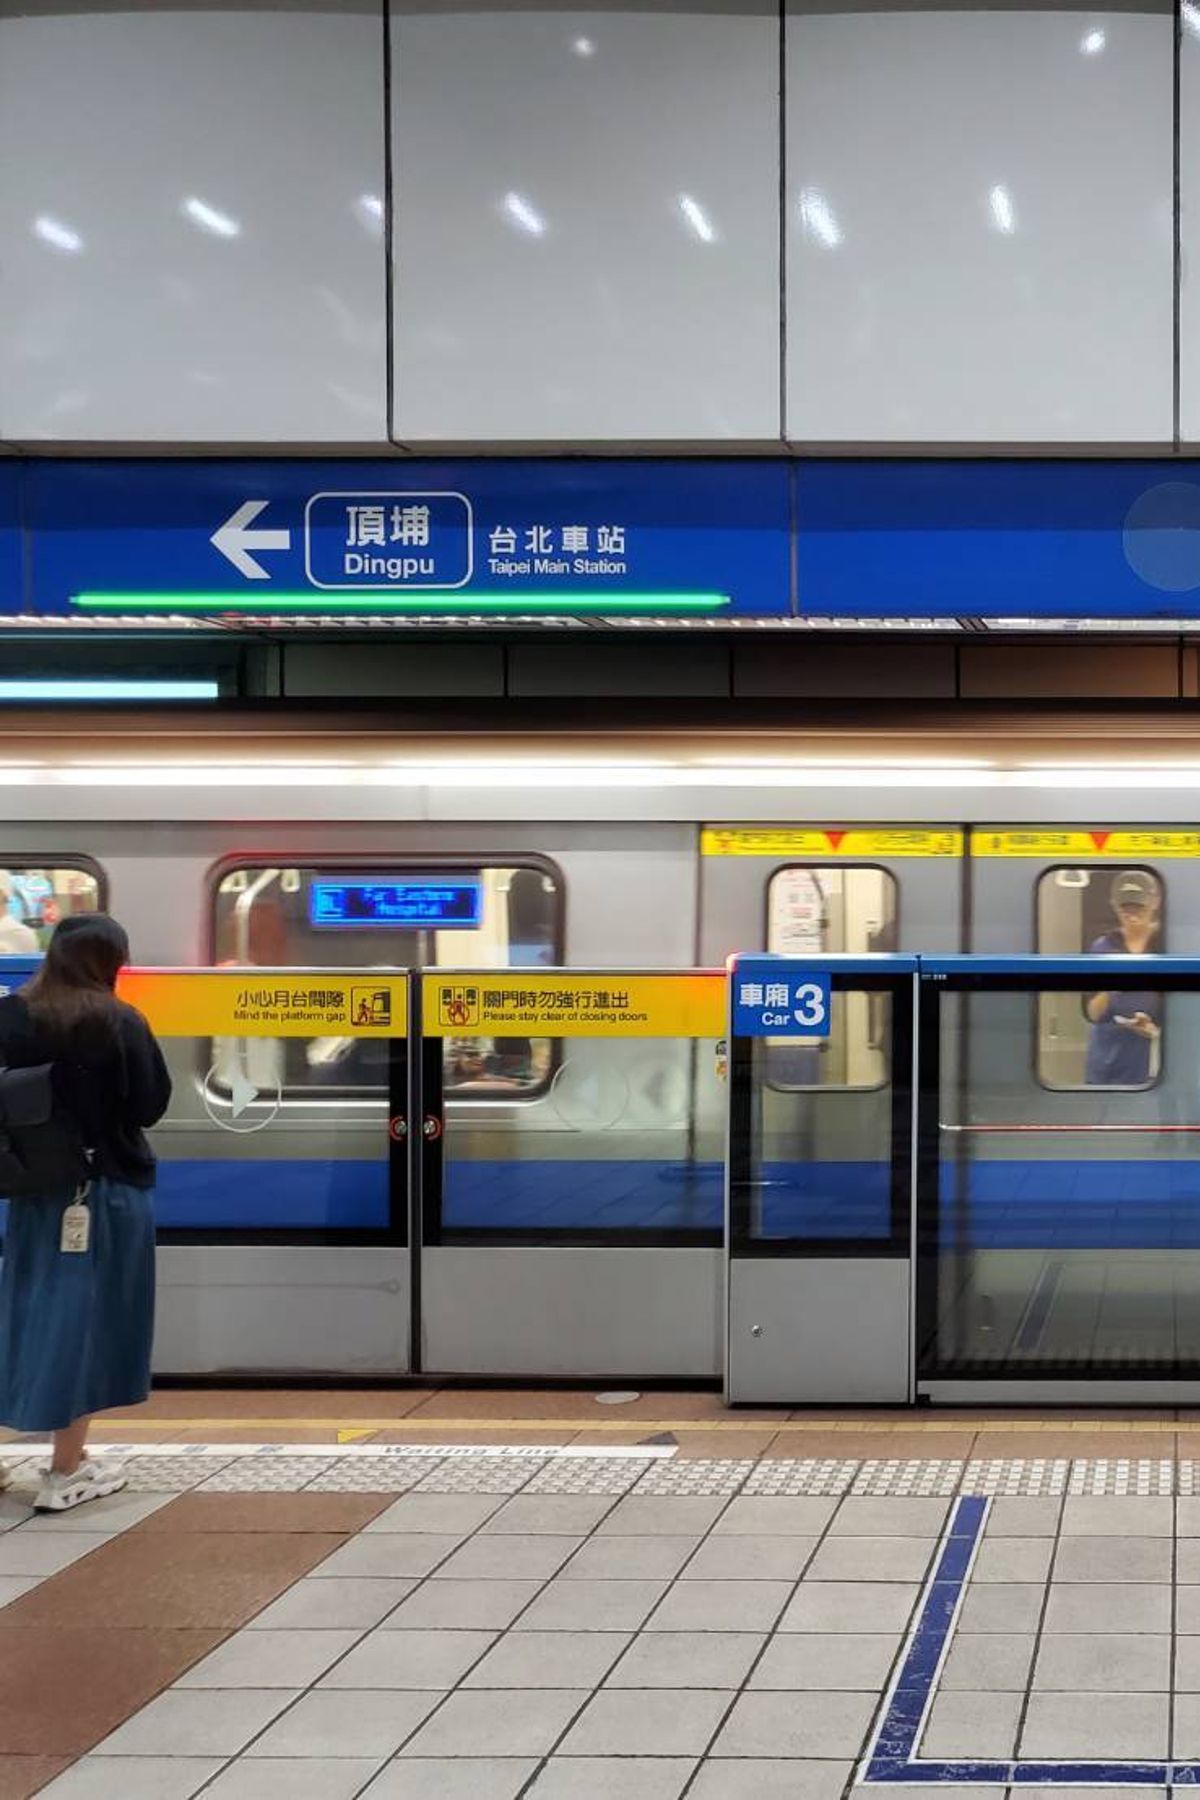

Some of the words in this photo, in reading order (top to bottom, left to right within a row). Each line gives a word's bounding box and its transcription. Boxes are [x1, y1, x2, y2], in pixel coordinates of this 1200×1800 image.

[346, 506, 430, 546] 頂埔
[489, 525, 626, 554] 台北車站
[344, 553, 434, 579] Dingpu
[488, 558, 531, 575] Taipei
[534, 558, 570, 574] Main
[573, 558, 626, 574] Station
[237, 989, 344, 1008] 小心月台間隙
[739, 983, 790, 1008] 車廂
[794, 983, 825, 1026] 3
[233, 1010, 258, 1021] Mind
[260, 1010, 279, 1021] the
[281, 1010, 324, 1022] platform
[325, 1012, 346, 1023] gap
[483, 1011, 517, 1021] Please
[518, 1011, 539, 1023] stay
[540, 1011, 565, 1021] clear
[567, 1011, 578, 1021] of
[580, 1011, 616, 1023] closing
[618, 1011, 647, 1021] doors
[761, 1012, 790, 1026] Car
